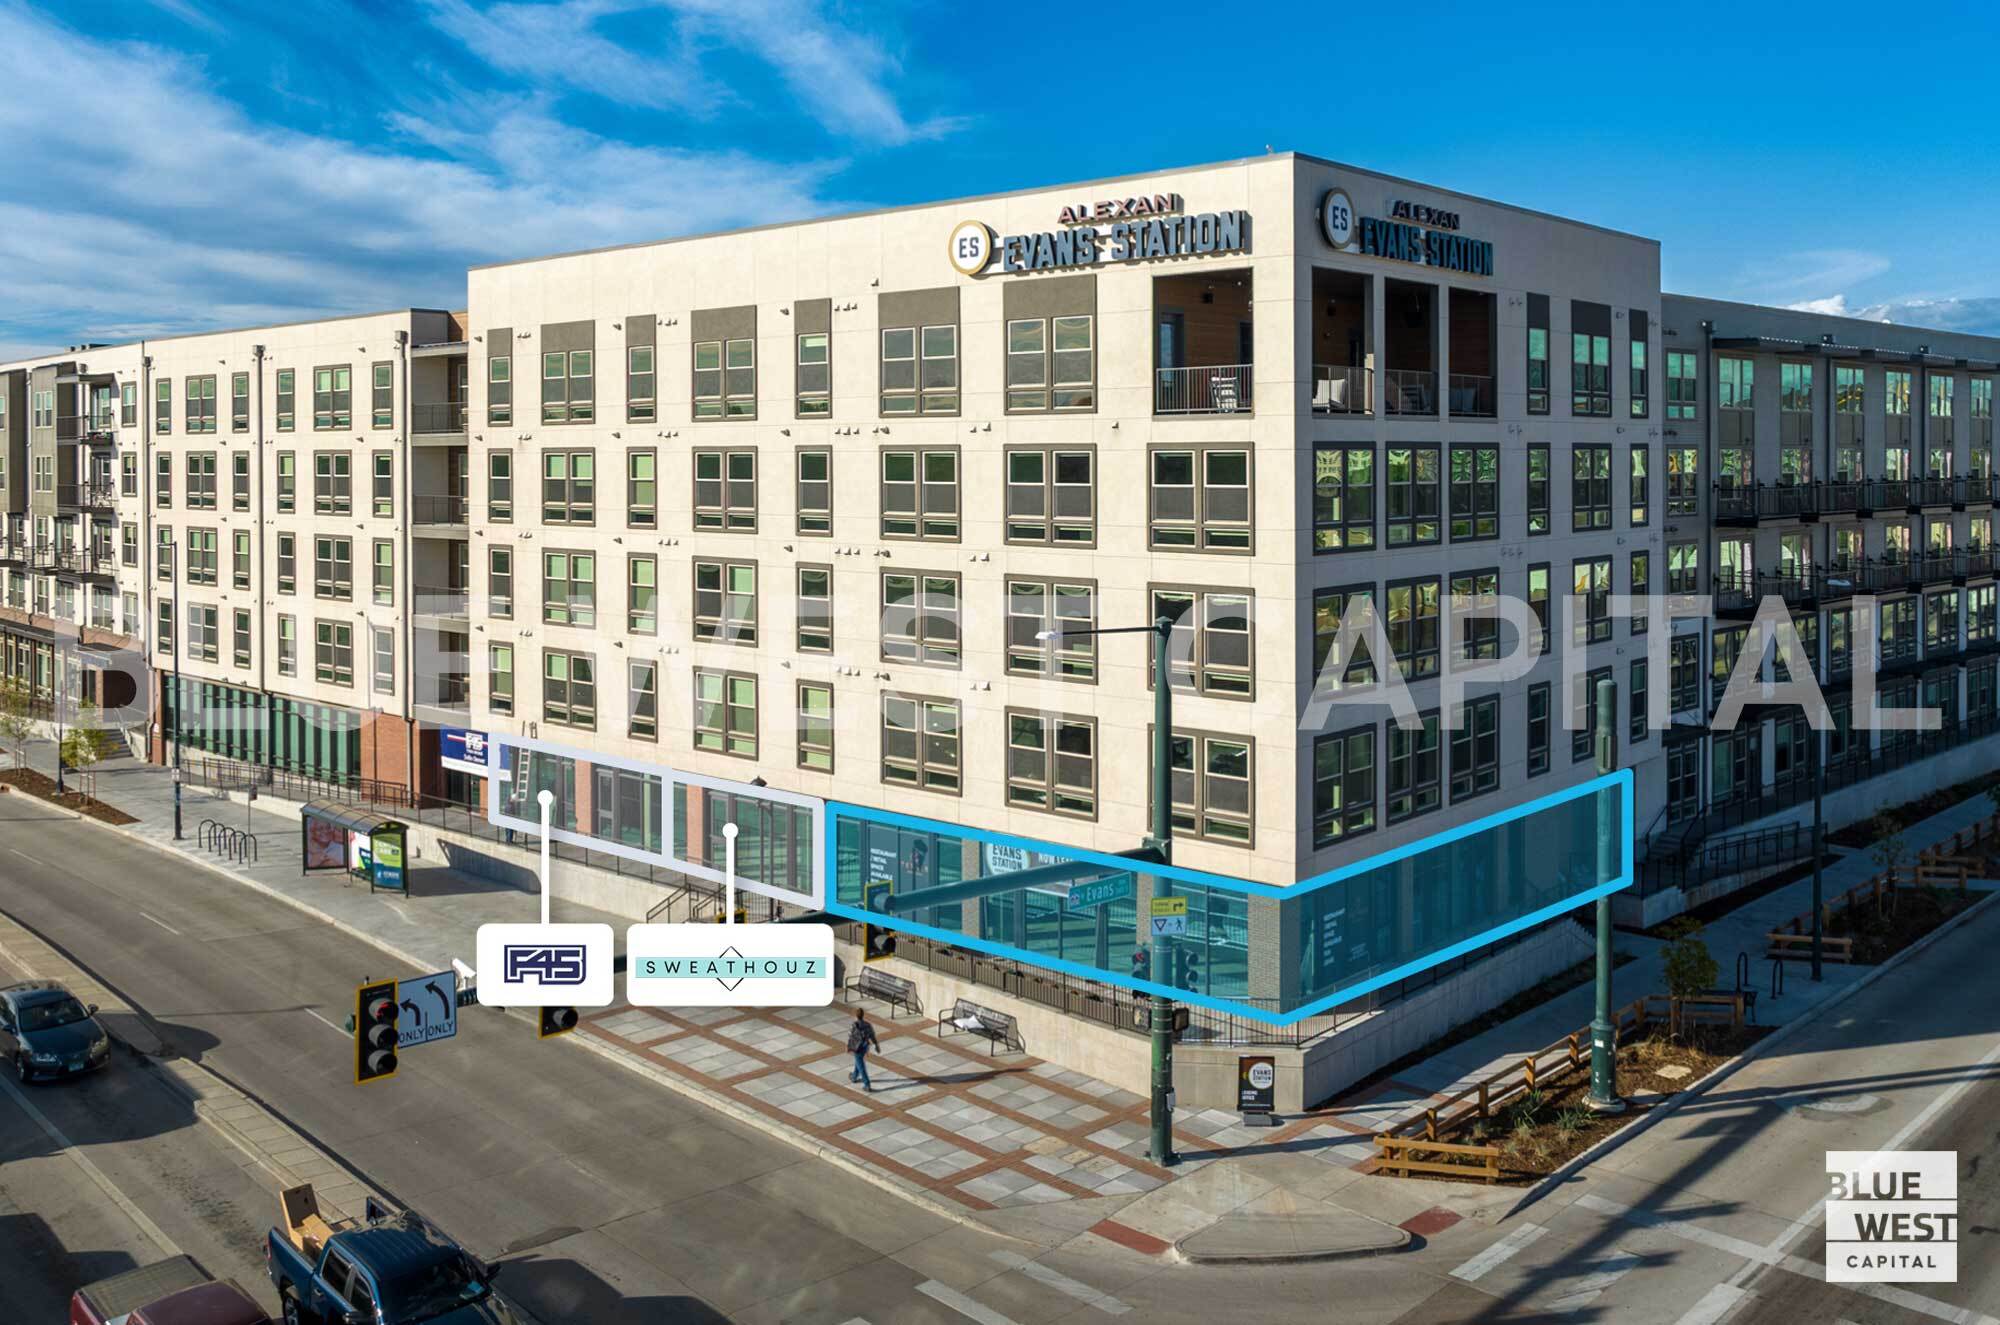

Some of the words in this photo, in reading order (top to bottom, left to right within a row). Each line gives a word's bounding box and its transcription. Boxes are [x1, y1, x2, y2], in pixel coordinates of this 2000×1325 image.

[1058, 193, 1178, 223] ALEXAN
[1332, 205, 1348, 231] ES
[1392, 201, 1458, 229] ALEXAN
[958, 236, 980, 258] ES
[1003, 227, 1097, 272] EVANS
[1110, 211, 1250, 259] STATION
[1360, 217, 1422, 263] EVANS
[1424, 230, 1493, 275] STATION
[992, 845, 1022, 859] EVANS
[992, 856, 1022, 870] STATION
[1086, 883, 1114, 902] Evans
[398, 1027, 427, 1043] ONLY
[428, 1022, 453, 1036] ONLY
